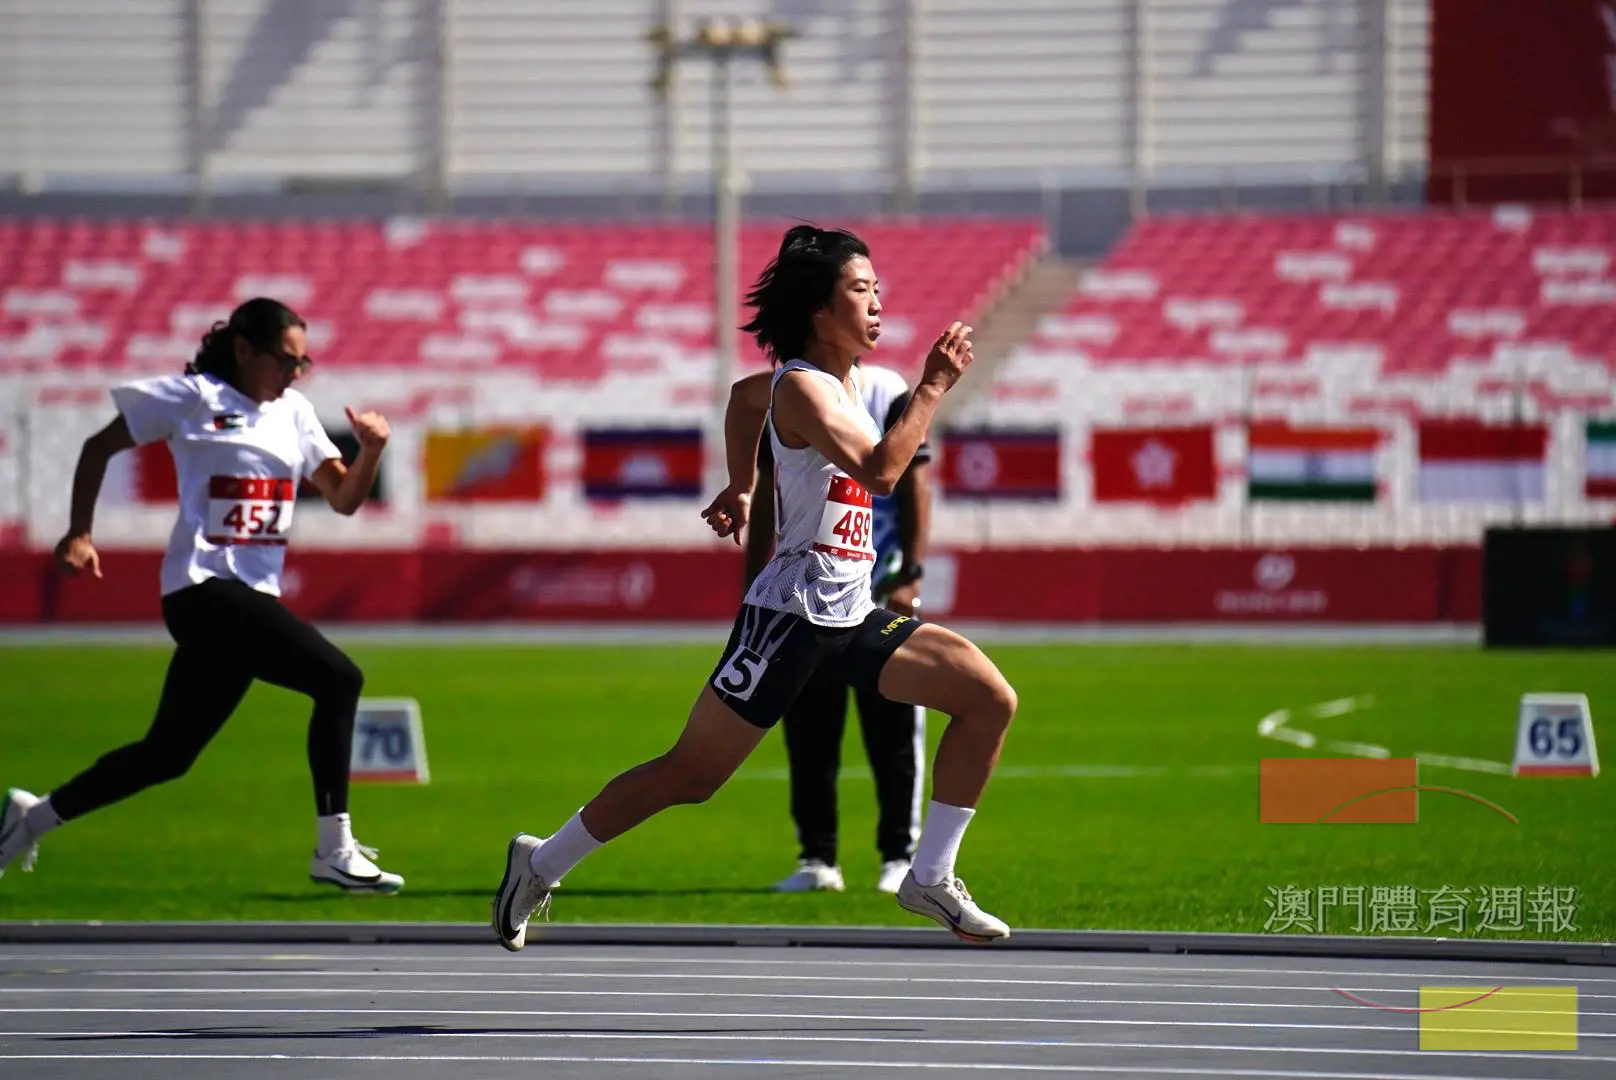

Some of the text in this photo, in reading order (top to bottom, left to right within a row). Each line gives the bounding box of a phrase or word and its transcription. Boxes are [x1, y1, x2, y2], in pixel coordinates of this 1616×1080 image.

[223, 504, 280, 534] 452
[832, 510, 871, 548] 489
[720, 648, 762, 693] 5
[357, 724, 409, 767] 70
[1528, 717, 1581, 759] 65
